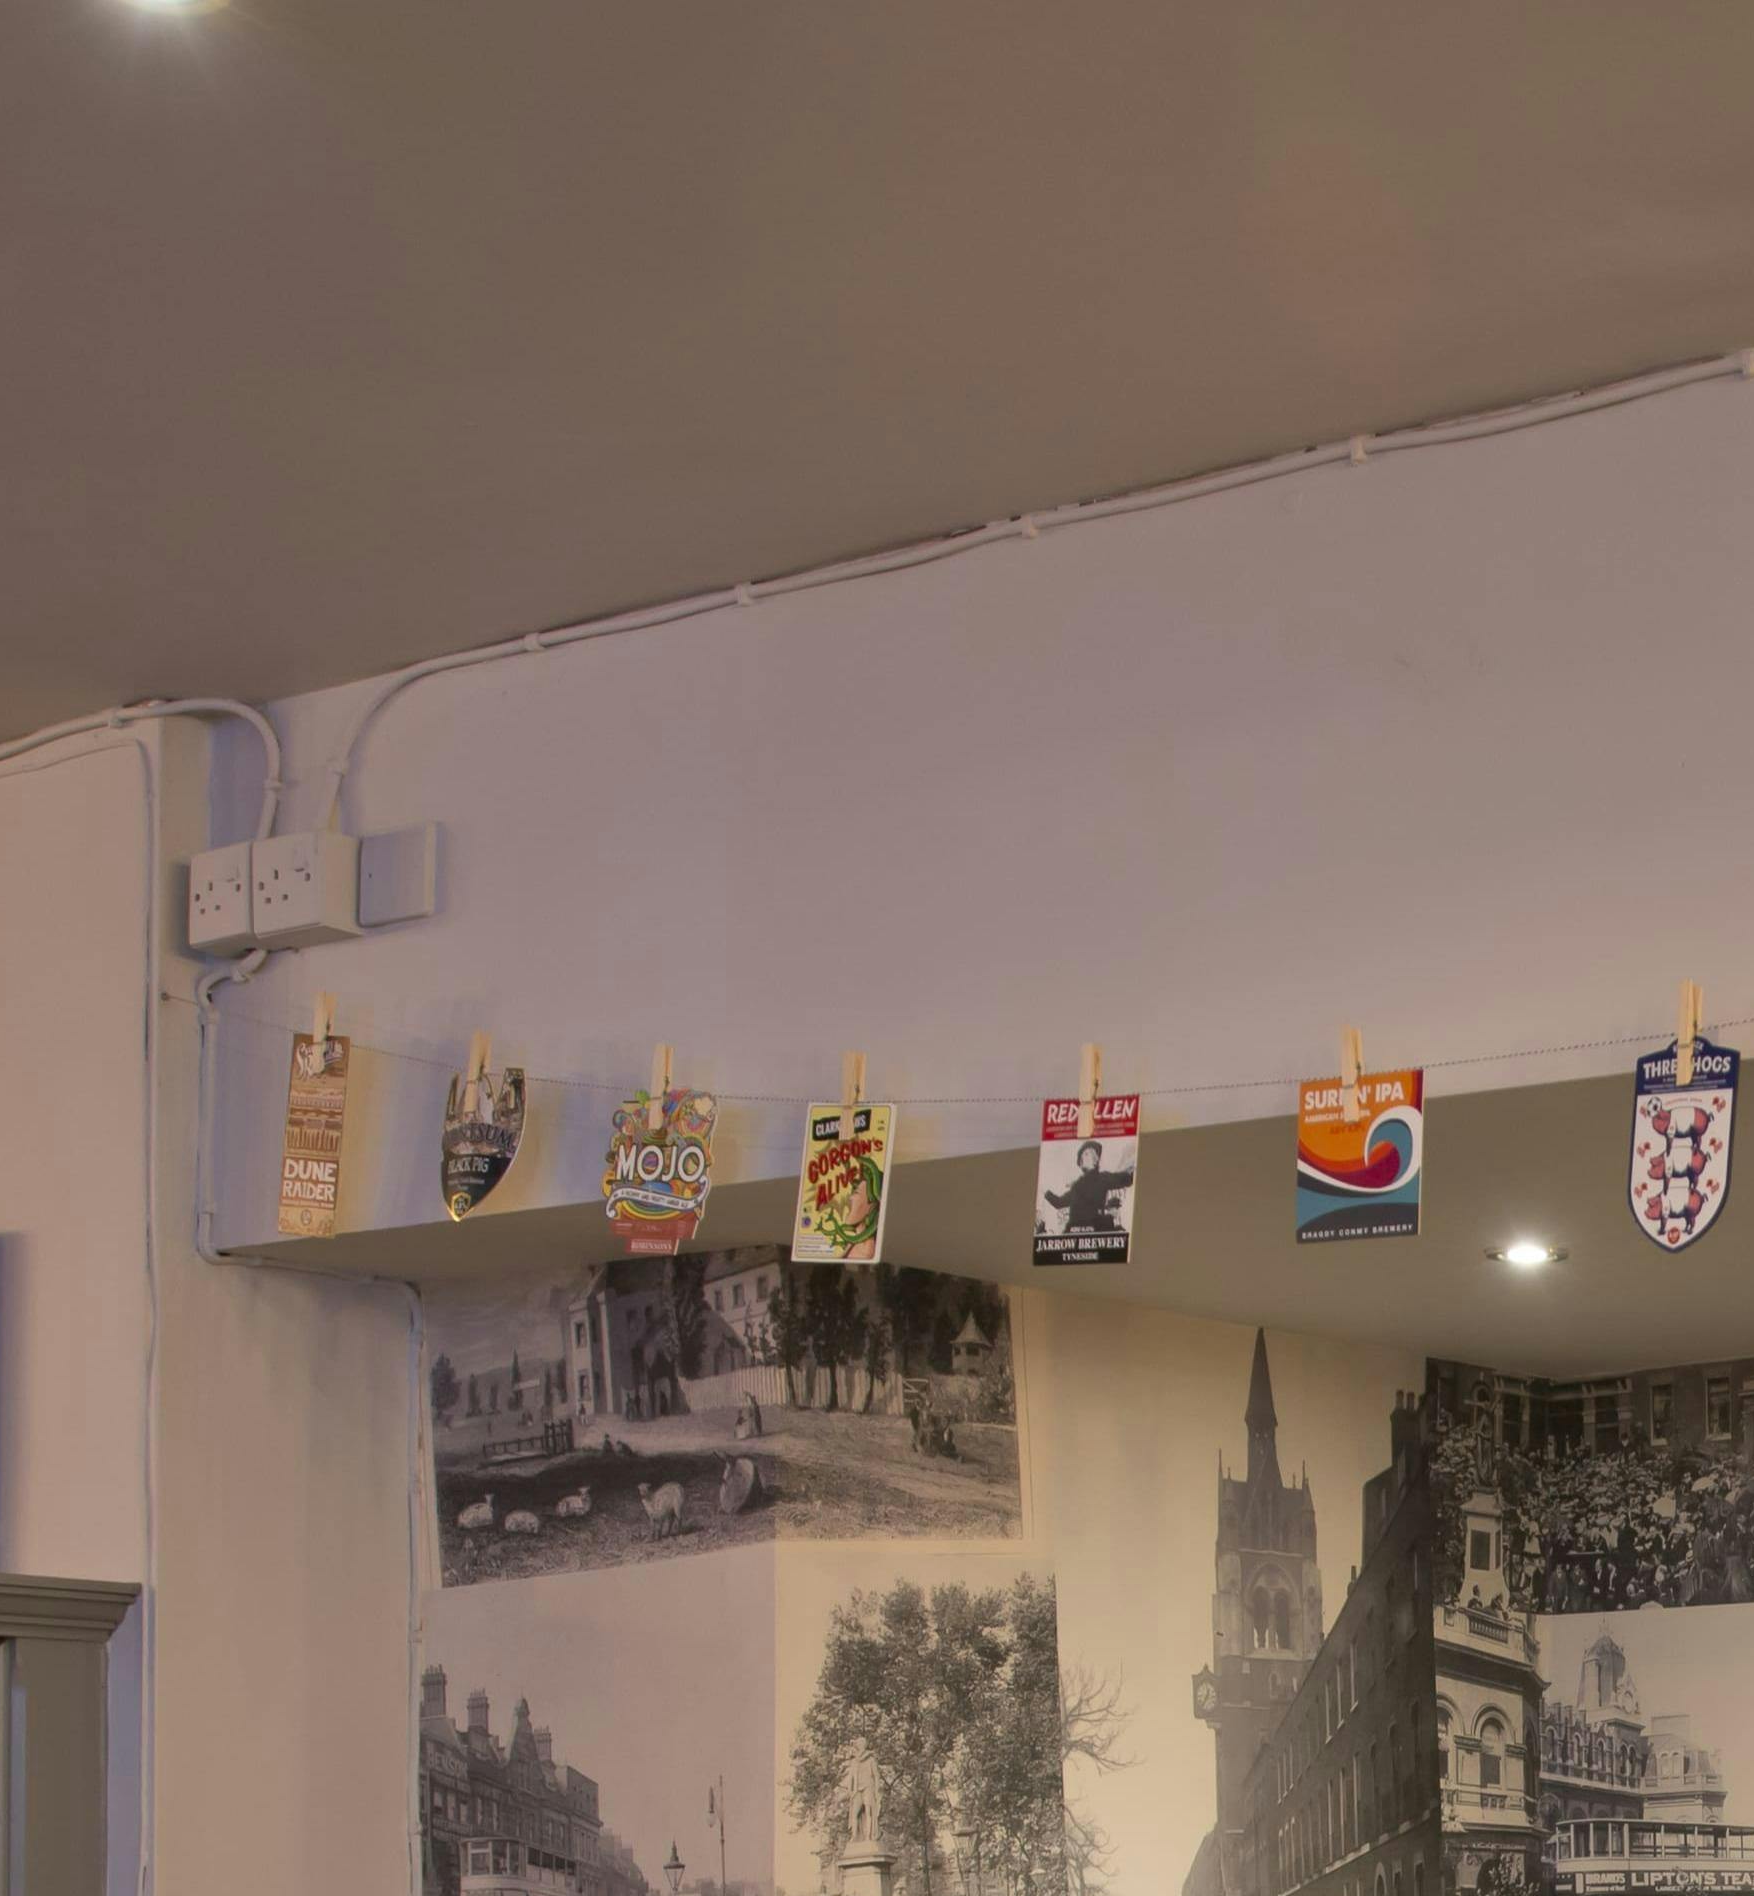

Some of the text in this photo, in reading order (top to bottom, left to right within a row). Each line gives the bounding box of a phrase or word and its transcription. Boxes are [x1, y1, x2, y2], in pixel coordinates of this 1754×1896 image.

[1643, 1055, 1732, 1080] THRE HOGS
[1375, 1081, 1405, 1103] IPA
[1047, 1099, 1136, 1124] RED LLEN
[284, 1158, 337, 1183] DUNE
[472, 1156, 490, 1174] PIG
[616, 1144, 705, 1183] MOJO
[807, 1137, 884, 1185] GORGON'S
[282, 1180, 335, 1202] RAIDER
[1036, 1236, 1126, 1253] JARROW BREWERY
[1721, 1872, 1752, 1886] TEA
